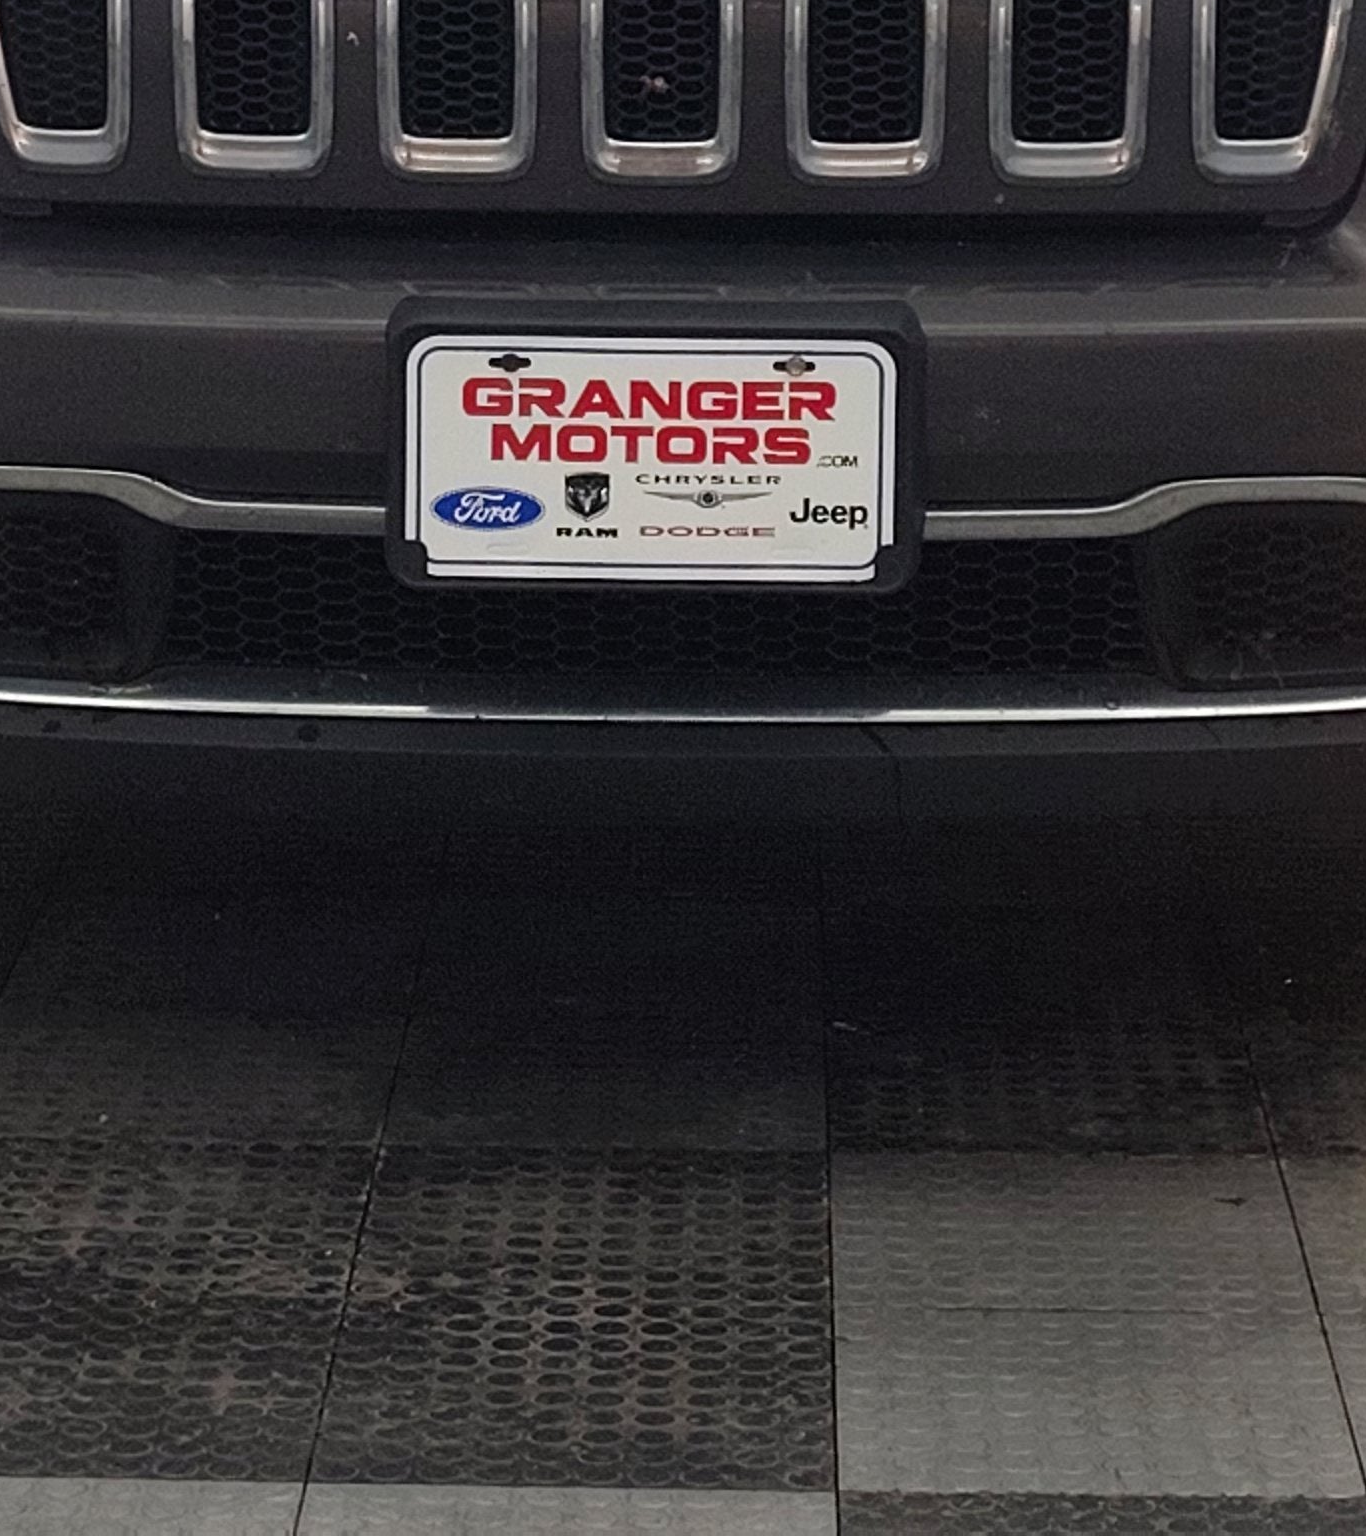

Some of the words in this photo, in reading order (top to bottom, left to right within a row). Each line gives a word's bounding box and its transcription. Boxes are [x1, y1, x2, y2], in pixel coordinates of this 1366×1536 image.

[462, 377, 837, 421] GRANGER
[491, 423, 811, 465] MOTORS
[635, 473, 782, 485] CHRYSLER
[454, 491, 522, 524] Ford
[789, 497, 869, 530] Jeep
[555, 527, 619, 539] RAM
[639, 526, 776, 538] DODGE
